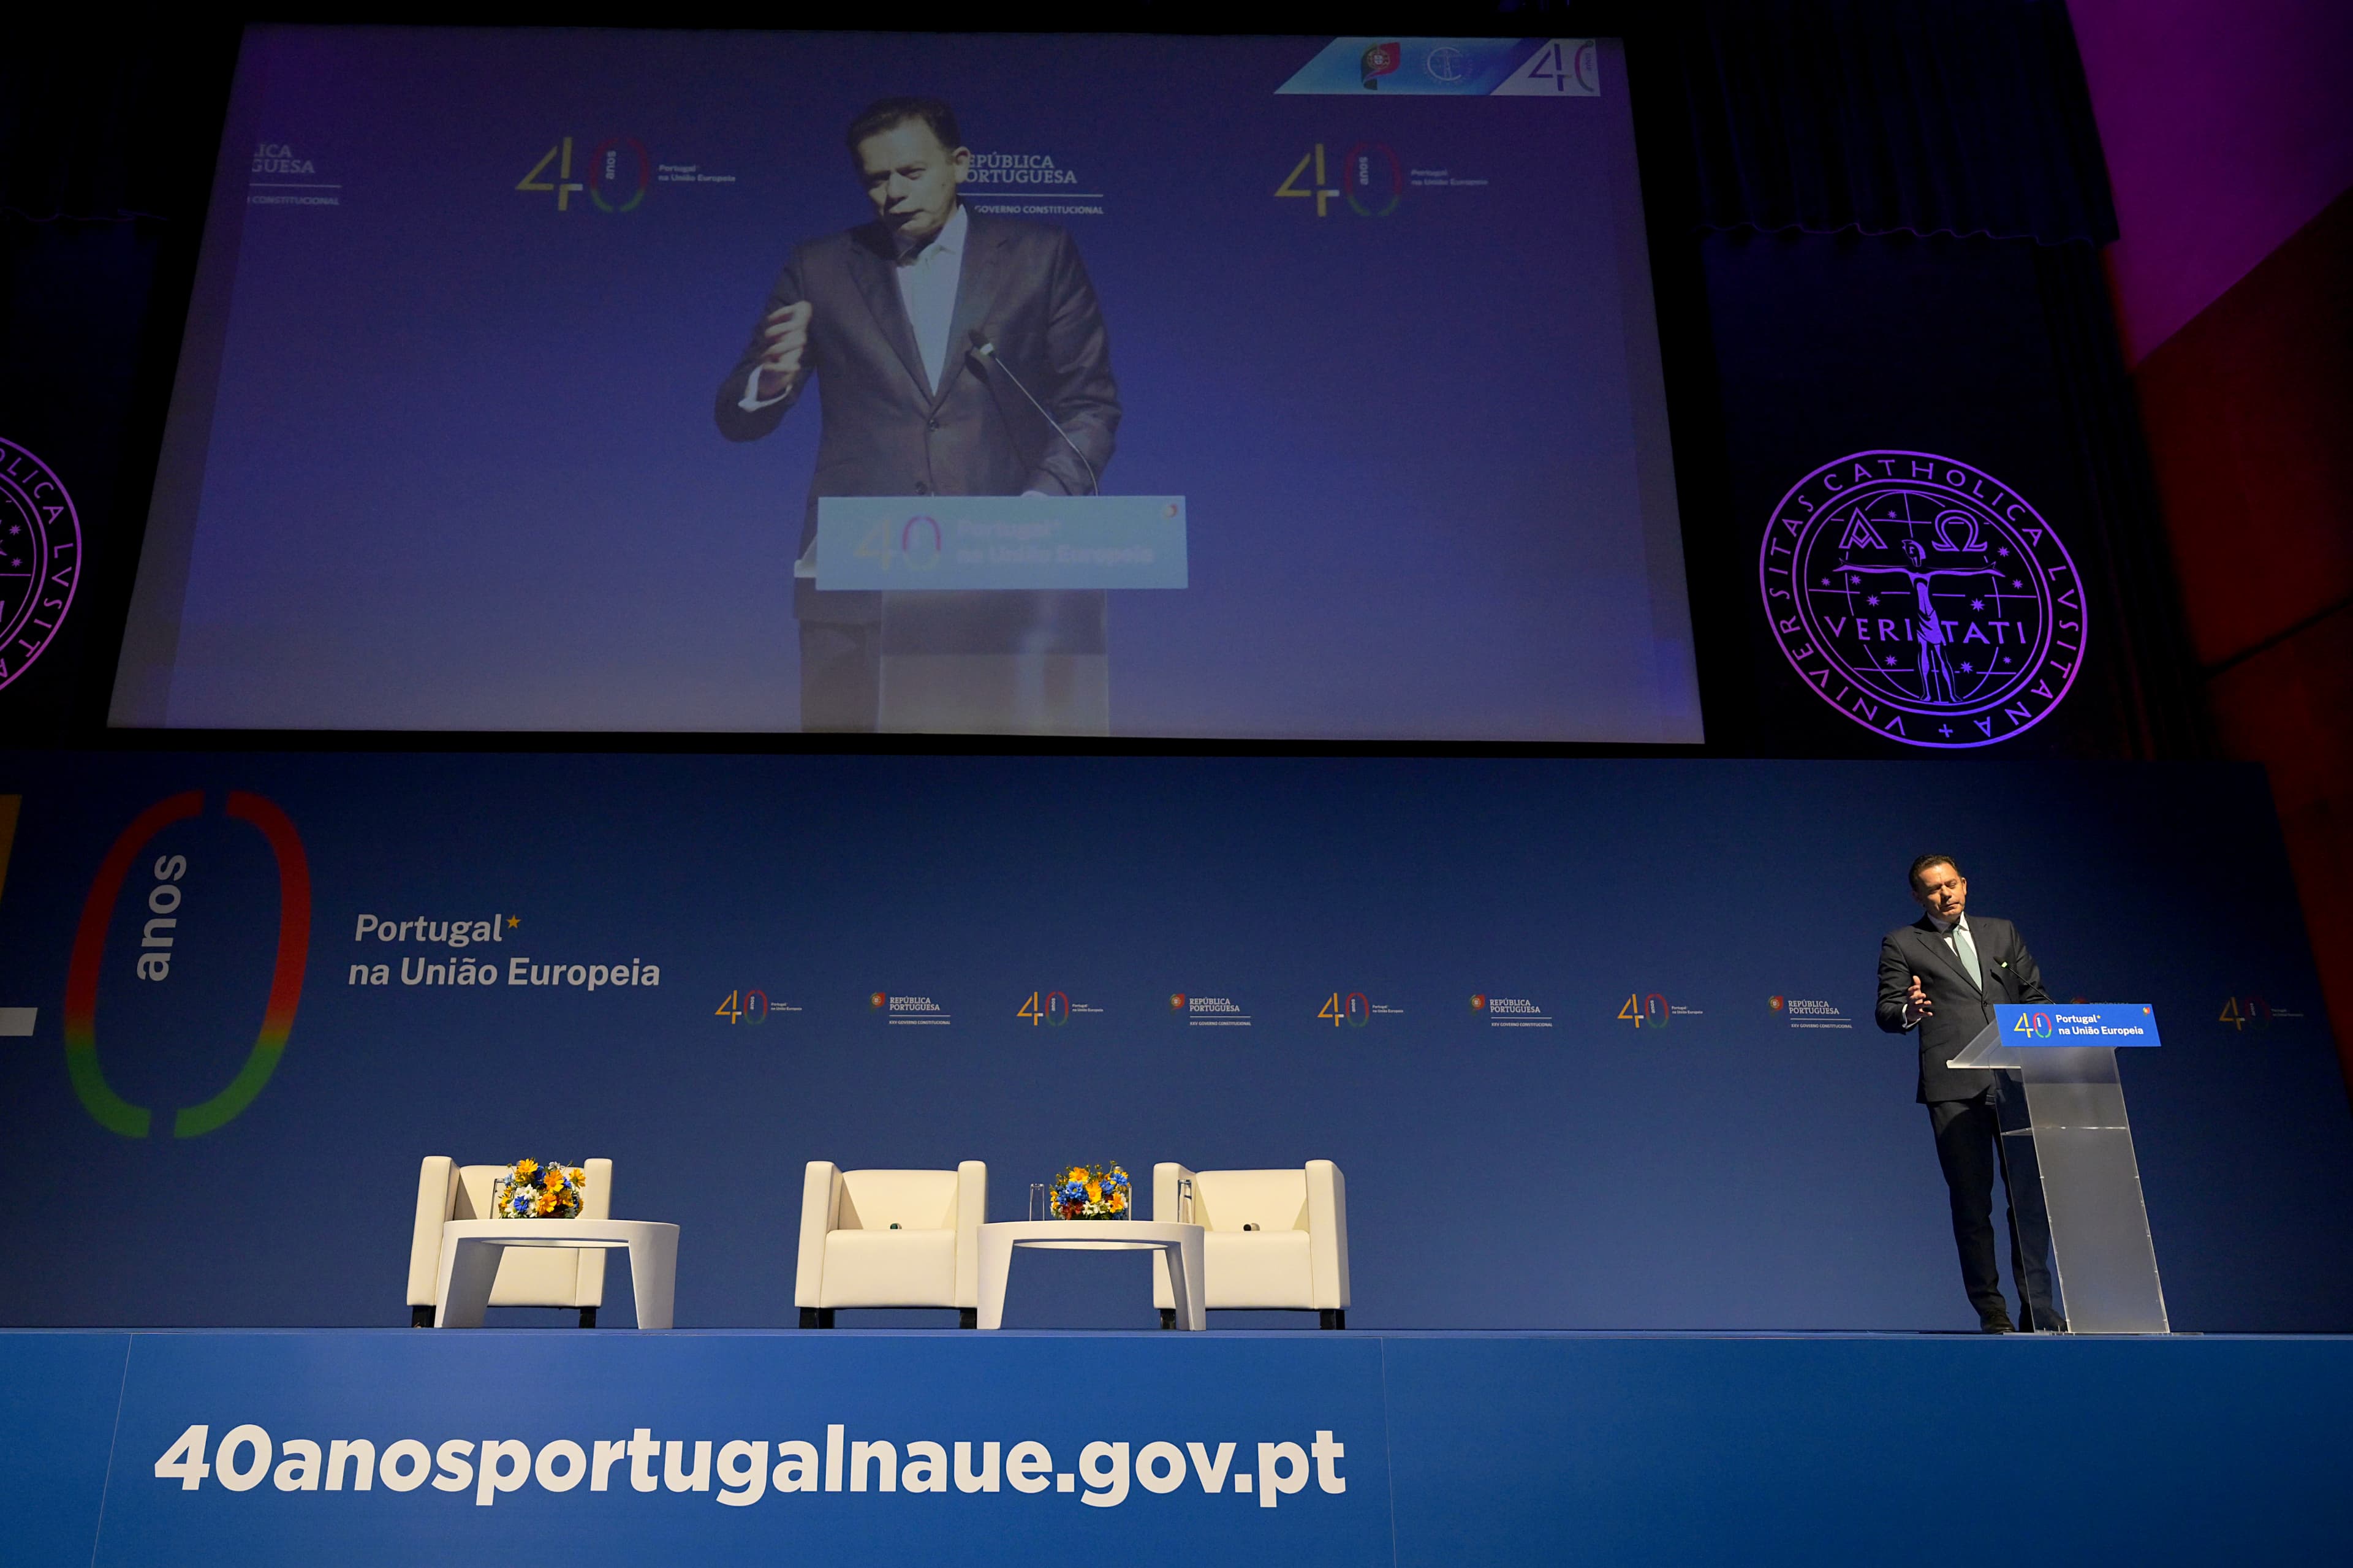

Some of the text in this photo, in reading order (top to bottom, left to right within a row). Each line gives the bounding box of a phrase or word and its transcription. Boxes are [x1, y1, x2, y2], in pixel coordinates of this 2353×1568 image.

[515, 137, 650, 212] 40
[964, 169, 1078, 184] ORTUGUESA
[968, 151, 1055, 169] EPÚBLICA
[1275, 142, 1402, 218] 40
[1023, 206, 1104, 214] CONSTITUCIONAL
[1768, 459, 2082, 737] VNIVERSITAS CATHOLICA LVSITANA
[137, 855, 188, 982] anos
[355, 914, 503, 948] Portugal
[348, 957, 661, 991] na União Europeia
[714, 990, 768, 1025] 40
[890, 996, 931, 1004] REPÚBLICA
[1017, 991, 1069, 1026] 40
[1189, 996, 1230, 1005] REPÚBLICA
[1317, 992, 1370, 1028] 40
[1490, 998, 1531, 1006] REPÚBLICA
[1617, 993, 1669, 1029] 40
[1788, 999, 1829, 1007] REPÚBLICA
[2014, 1012, 2053, 1038] 40
[2056, 1014, 2097, 1025] Portugal
[2072, 1026, 2100, 1036] União
[2101, 1026, 2144, 1036] Europeia
[154, 1423, 1346, 1507] 40anosportugalnaue.gov.pt
